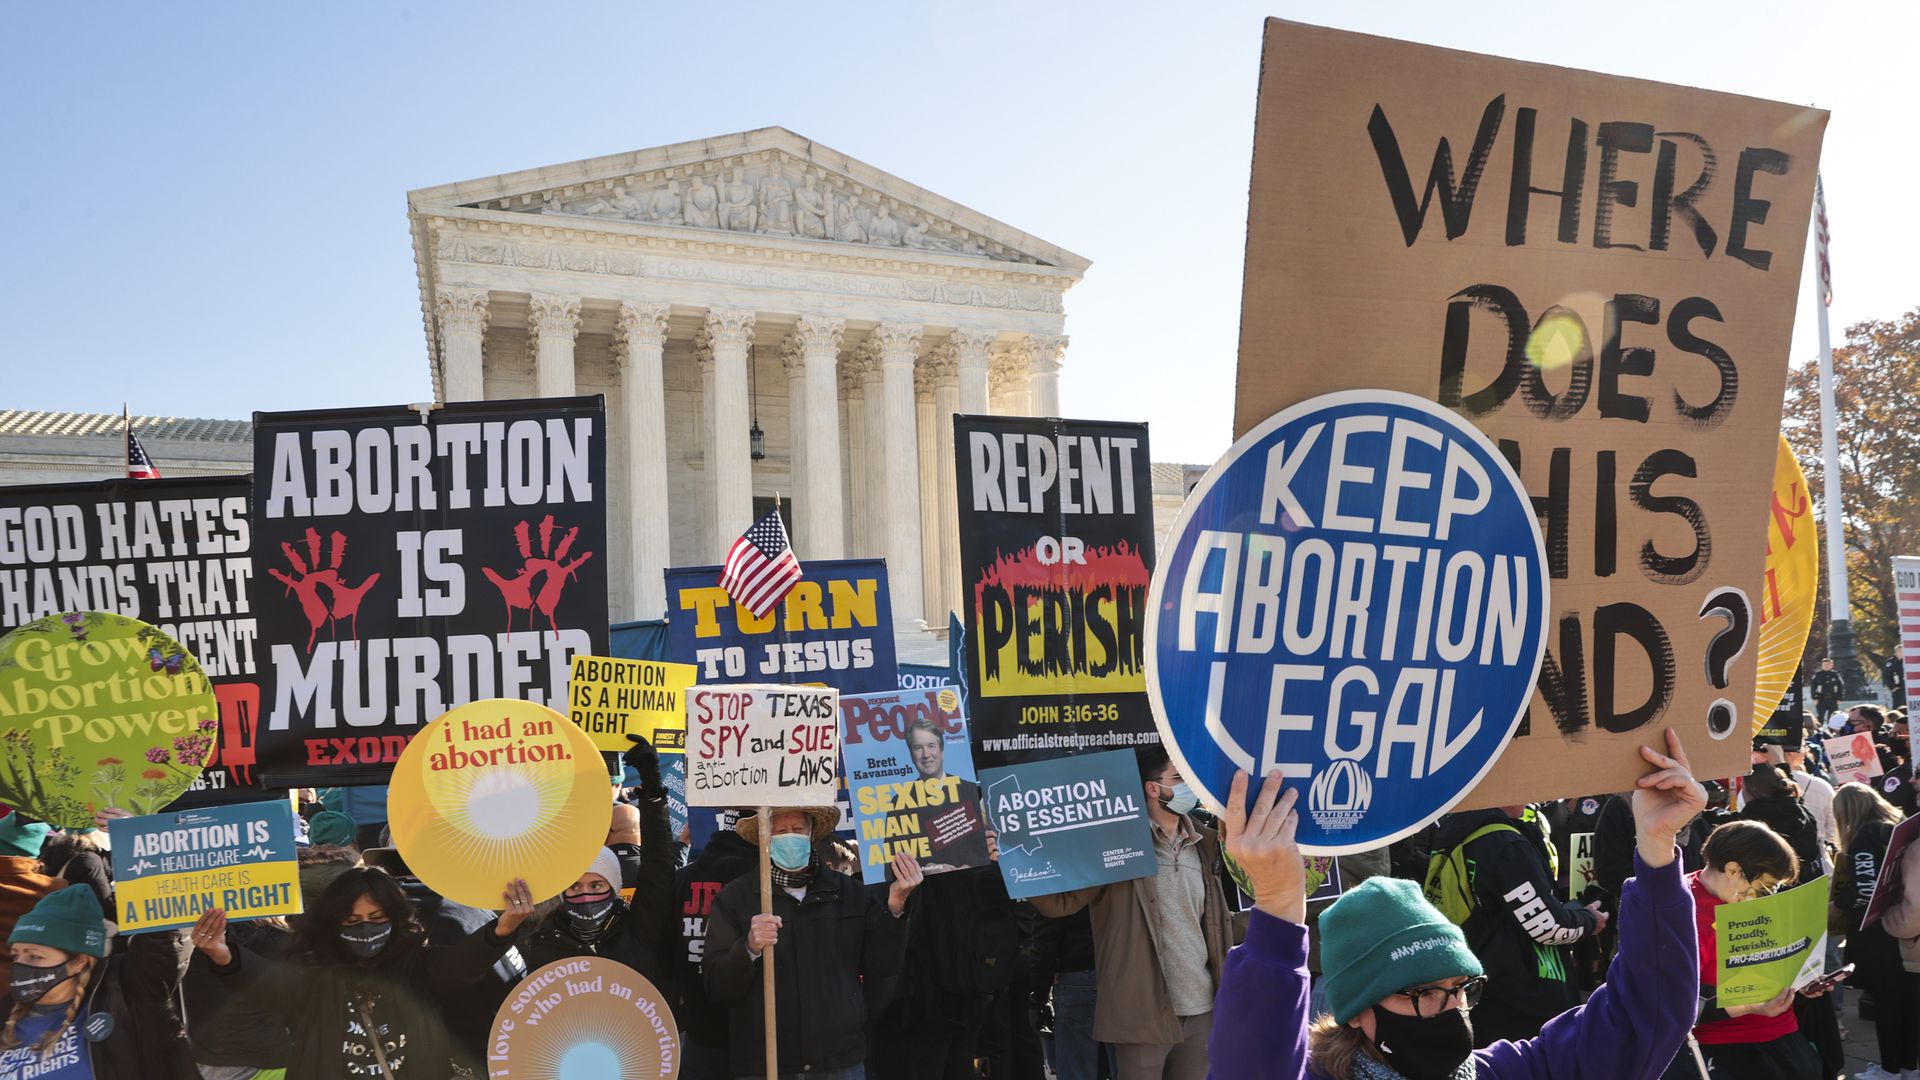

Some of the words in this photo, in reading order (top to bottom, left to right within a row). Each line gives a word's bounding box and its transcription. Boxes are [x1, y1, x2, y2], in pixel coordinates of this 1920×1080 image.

[1367, 93, 1794, 271] WHERE
[656, 262, 719, 281] EQUAL
[721, 267, 792, 288] JUSTICE
[798, 275, 851, 292] UNDER
[1440, 283, 1739, 432] DOES
[266, 417, 593, 518] ABORTION
[969, 431, 1138, 514] REPENT
[1259, 415, 1492, 541] KEEP
[1498, 438, 1712, 586] HIS
[0, 504, 88, 565] GOD
[96, 497, 251, 560] HATES
[1036, 535, 1087, 566] OR
[396, 529, 466, 618] IS
[1896, 570, 1915, 588] GOD
[0, 563, 141, 628] HANDS
[147, 557, 254, 618] THAT
[1178, 530, 1529, 666] ABORTION
[981, 583, 1146, 683] PERISH
[15, 635, 155, 682] Grow
[574, 659, 666, 687] ABORTION
[696, 646, 746, 679] TO
[759, 638, 874, 675] JESUS
[1514, 602, 1677, 742] ND
[1699, 586, 1753, 741] ?
[574, 685, 592, 708] IS
[598, 688, 610, 708] A
[616, 688, 676, 712] HUMAN
[695, 691, 753, 724] STOP
[766, 693, 833, 718] TEXAS
[1018, 706, 1059, 725] JOHN
[1063, 703, 1119, 724] 3:16-36
[33, 705, 209, 749] Power
[443, 720, 452, 743] i
[462, 717, 512, 742] had
[523, 720, 553, 737] an
[572, 711, 629, 735] RIGHT
[839, 691, 965, 745] People
[1204, 661, 1484, 779] LEGAL
[304, 735, 415, 766] EXOD
[430, 738, 572, 771] abortion.
[700, 723, 750, 760] SPY
[751, 729, 785, 753] and
[788, 724, 835, 755] SUE
[982, 730, 1160, 751] www.officialstreetpreachers.com
[1831, 750, 1850, 760] RIGHT
[695, 762, 768, 790] abortion
[696, 761, 726, 770] anti-
[854, 764, 913, 780] Kavanaugh
[867, 756, 897, 769] Brett
[857, 775, 961, 815] SEXIST
[998, 779, 1107, 813] ABORTION
[1308, 760, 1372, 811] NOW
[862, 813, 920, 841] MAN
[1000, 814, 1021, 833] IS
[1026, 795, 1139, 830] ESSENTIAL
[1312, 811, 1364, 819] NATIONAL
[133, 823, 239, 858] ABORTION
[247, 820, 270, 844] IS
[1102, 849, 1124, 857] CENTER
[161, 856, 205, 873] HEALTH
[207, 849, 241, 868] CARE
[1103, 850, 1145, 863] REPRODUCTIVE
[1104, 860, 1125, 868] RIGHTS
[1855, 852, 1875, 876] CRY
[157, 876, 199, 896] HEALTH
[202, 871, 234, 890] CARE
[238, 870, 251, 885] IS
[126, 901, 138, 923] A
[144, 891, 215, 921] HUMAN
[223, 882, 291, 912] RIGHT
[1728, 915, 1773, 930] Proudly,
[1728, 927, 1768, 942] Loudly,
[1728, 938, 1778, 954] Jewishly,
[1728, 946, 1787, 965] PRO-ABORTION
[511, 959, 591, 1014] someone
[489, 1018, 516, 1062] love
[525, 992, 562, 1026] who
[565, 975, 603, 997] had
[609, 982, 633, 1001] an
[635, 997, 675, 1078] abortion.
[22, 1051, 80, 1080] RIGHTS
[490, 1069, 510, 1077] i
